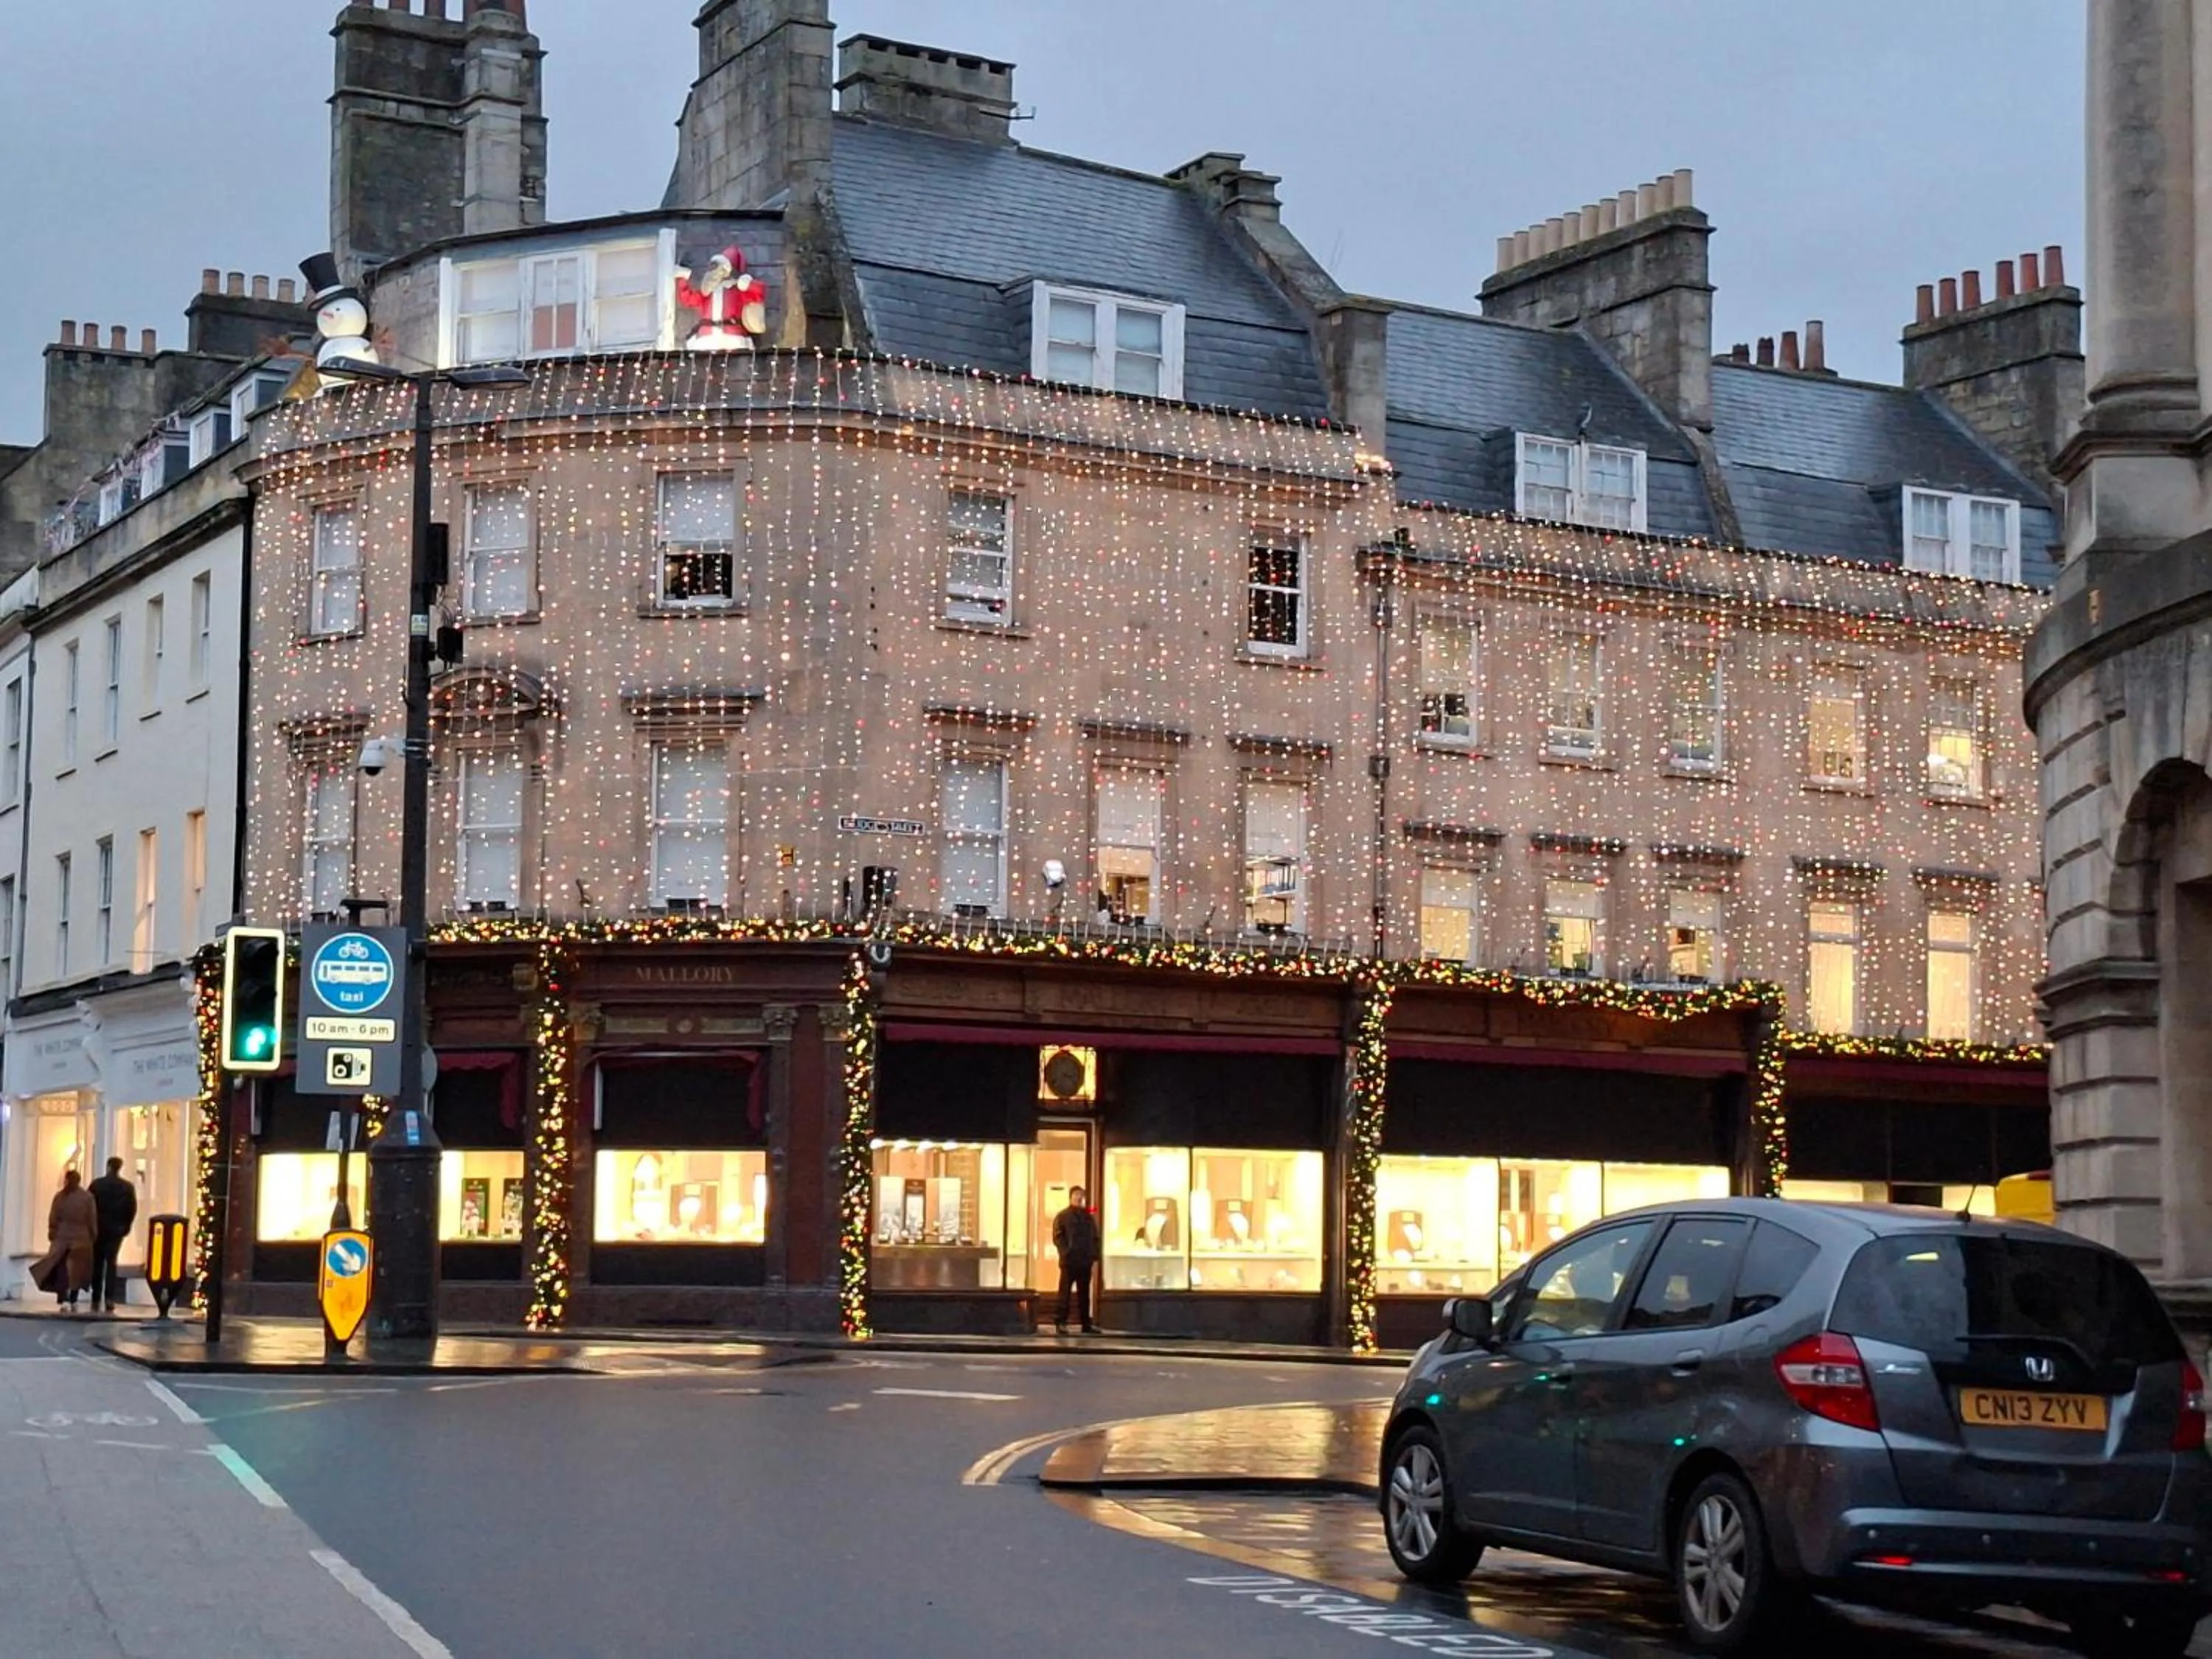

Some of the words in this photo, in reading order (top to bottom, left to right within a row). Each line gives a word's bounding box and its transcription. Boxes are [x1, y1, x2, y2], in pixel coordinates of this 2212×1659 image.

[636, 967, 733, 982] MALLORY
[340, 990, 364, 1003] taxi
[313, 1022, 326, 1034] 10
[330, 1026, 348, 1034] am
[359, 1023, 366, 1034] 6
[370, 1026, 389, 1036] pm
[1975, 1393, 2032, 1422] CN13
[2038, 1398, 2087, 1425] ZYV
[1186, 1576, 1554, 1658] DISABLED
